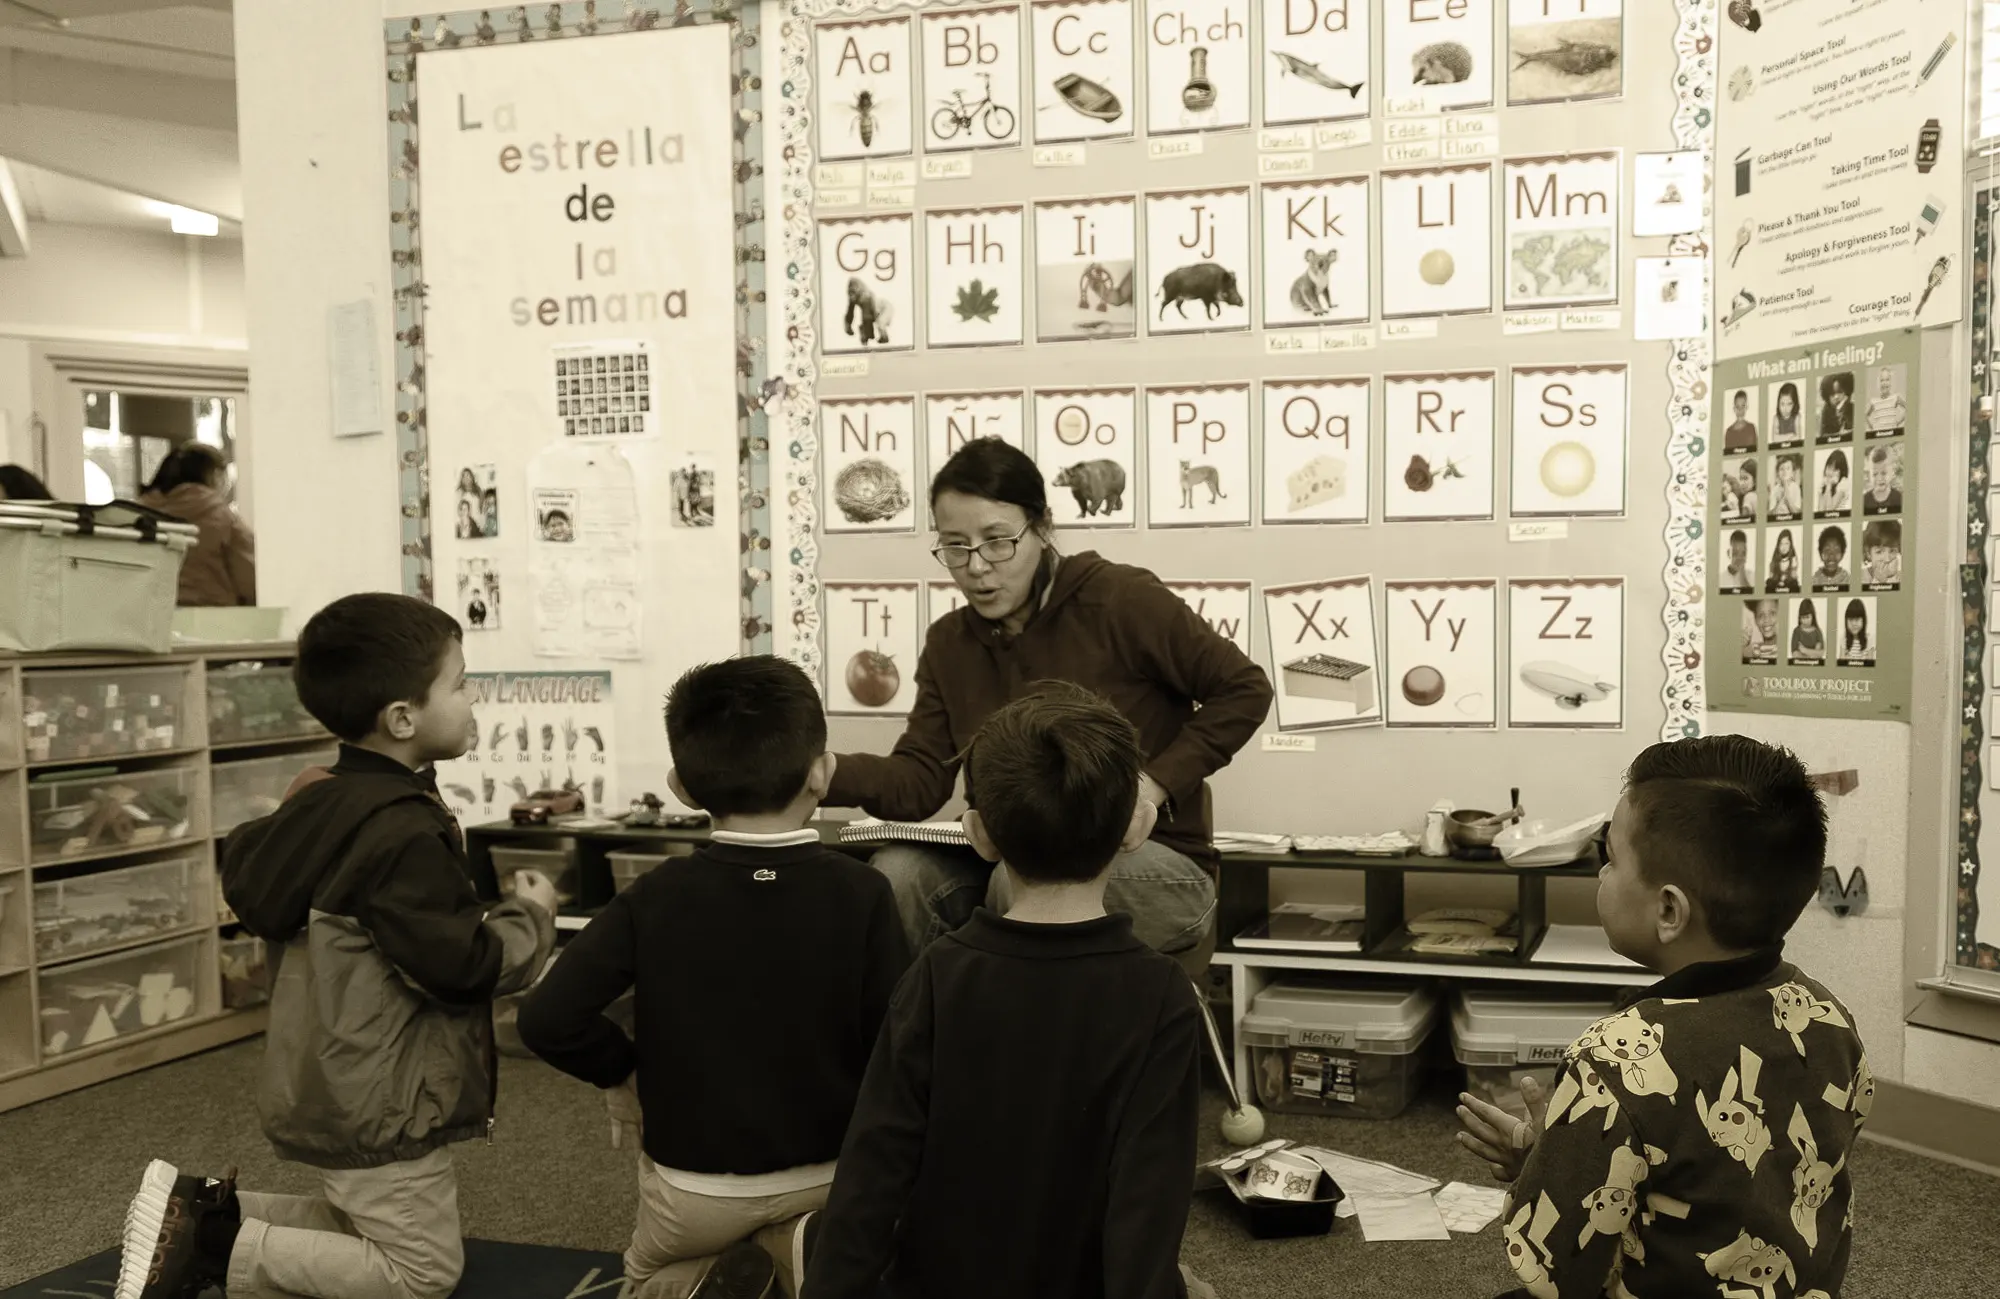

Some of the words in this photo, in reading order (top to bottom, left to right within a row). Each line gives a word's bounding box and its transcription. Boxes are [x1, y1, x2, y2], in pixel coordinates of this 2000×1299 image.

[1052, 14, 1109, 57] Cc
[1284, 0, 1349, 37] Dd
[836, 37, 891, 77] Aa
[943, 25, 1000, 68] Bb
[1760, 52, 1798, 76] Personal
[1800, 46, 1824, 62] Space
[1827, 35, 1846, 50] Tool
[1812, 80, 1838, 95] Using
[1840, 72, 1857, 86] Our
[1859, 61, 1889, 79] Words
[1891, 50, 1911, 68] Tool
[458, 93, 516, 133] La
[499, 126, 684, 174] estrella
[1757, 147, 1793, 165] Garbage
[1795, 140, 1812, 153] Can
[1813, 131, 1832, 147] Tool
[1831, 159, 1862, 176] Taking
[1863, 152, 1887, 167] Time
[1888, 143, 1909, 159] Tool
[565, 183, 616, 223] de
[1418, 182, 1455, 229] Ll
[1516, 173, 1608, 220] Mm
[1758, 219, 1785, 234] Please
[1786, 215, 1793, 226] &
[1794, 208, 1821, 224] Thank
[1823, 203, 1839, 216] You
[1840, 195, 1861, 210] Tool
[1073, 215, 1097, 257] Ii
[1179, 206, 1217, 260] Jj
[1287, 197, 1345, 240] Kk
[575, 243, 617, 281] la
[836, 232, 897, 282] Gg
[945, 224, 1004, 266] Hh
[1785, 246, 1821, 263] Apology
[1823, 242, 1830, 253] &
[1831, 229, 1889, 251] Forgiveness
[1889, 220, 1911, 237] Tool
[510, 289, 689, 328] semana
[1759, 290, 1795, 306] Patience
[1796, 284, 1815, 298] Tool
[1848, 298, 1889, 315] Courage
[1891, 291, 1912, 305] Tool
[1747, 359, 1785, 380] What
[1788, 357, 1812, 373] am
[1814, 352, 1820, 369] I
[1822, 341, 1885, 368] feeling?
[1055, 405, 1117, 447] Oo
[1282, 396, 1350, 450] Qq
[1416, 391, 1466, 434] Rr
[1540, 384, 1598, 428] Ss
[840, 413, 898, 453] Nn
[1172, 402, 1227, 455] Pp
[851, 598, 893, 638] Tt
[1292, 600, 1350, 644] Xx
[1410, 598, 1467, 652] Yy
[1538, 596, 1594, 640] Zz
[496, 674, 604, 703] LANGUAGE
[1763, 677, 1817, 690] TOOLBOX
[1820, 678, 1875, 694] PROJECT
[1302, 1031, 1342, 1047] Hefty
[1532, 1047, 1565, 1059] Heft
